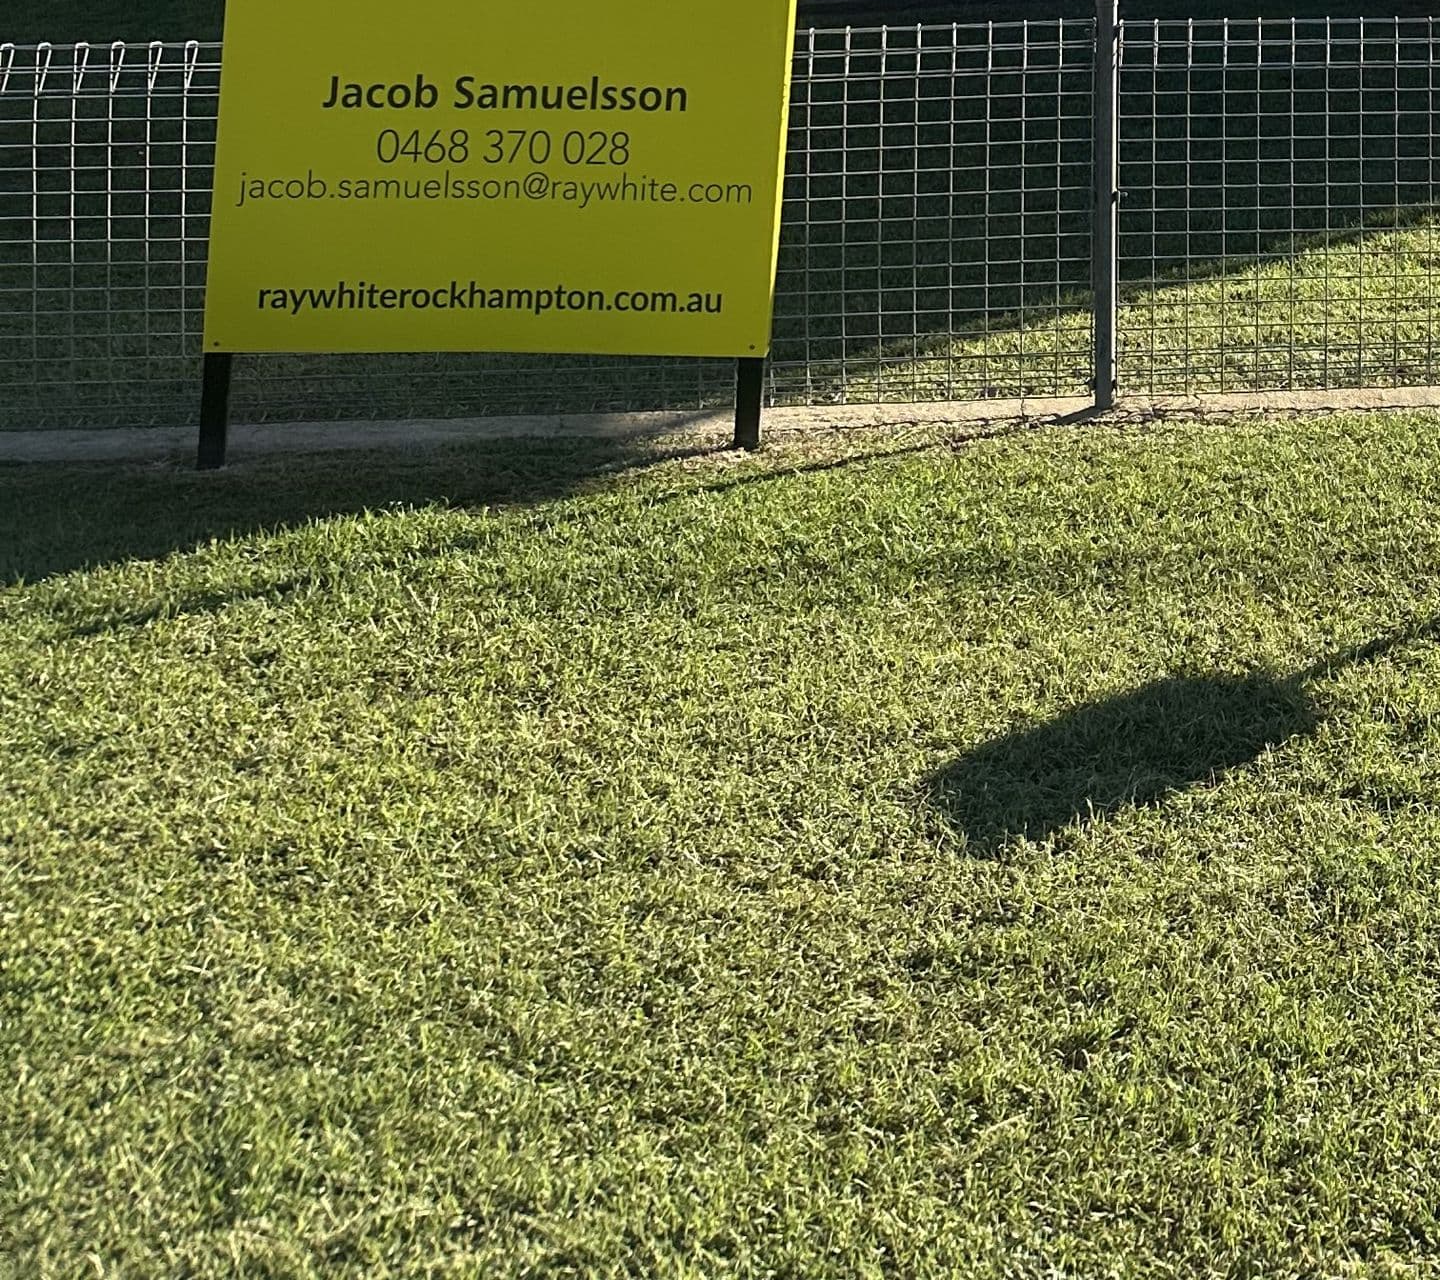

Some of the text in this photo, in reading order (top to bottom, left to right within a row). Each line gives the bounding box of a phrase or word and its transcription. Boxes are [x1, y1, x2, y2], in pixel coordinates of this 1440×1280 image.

[322, 74, 687, 112] Jacob Samuelsson
[376, 129, 630, 165] 0468 370 028
[235, 170, 753, 209] jacob.samuelsson@raywhite.com
[257, 281, 722, 315] raywhiterockhampton.com.au
